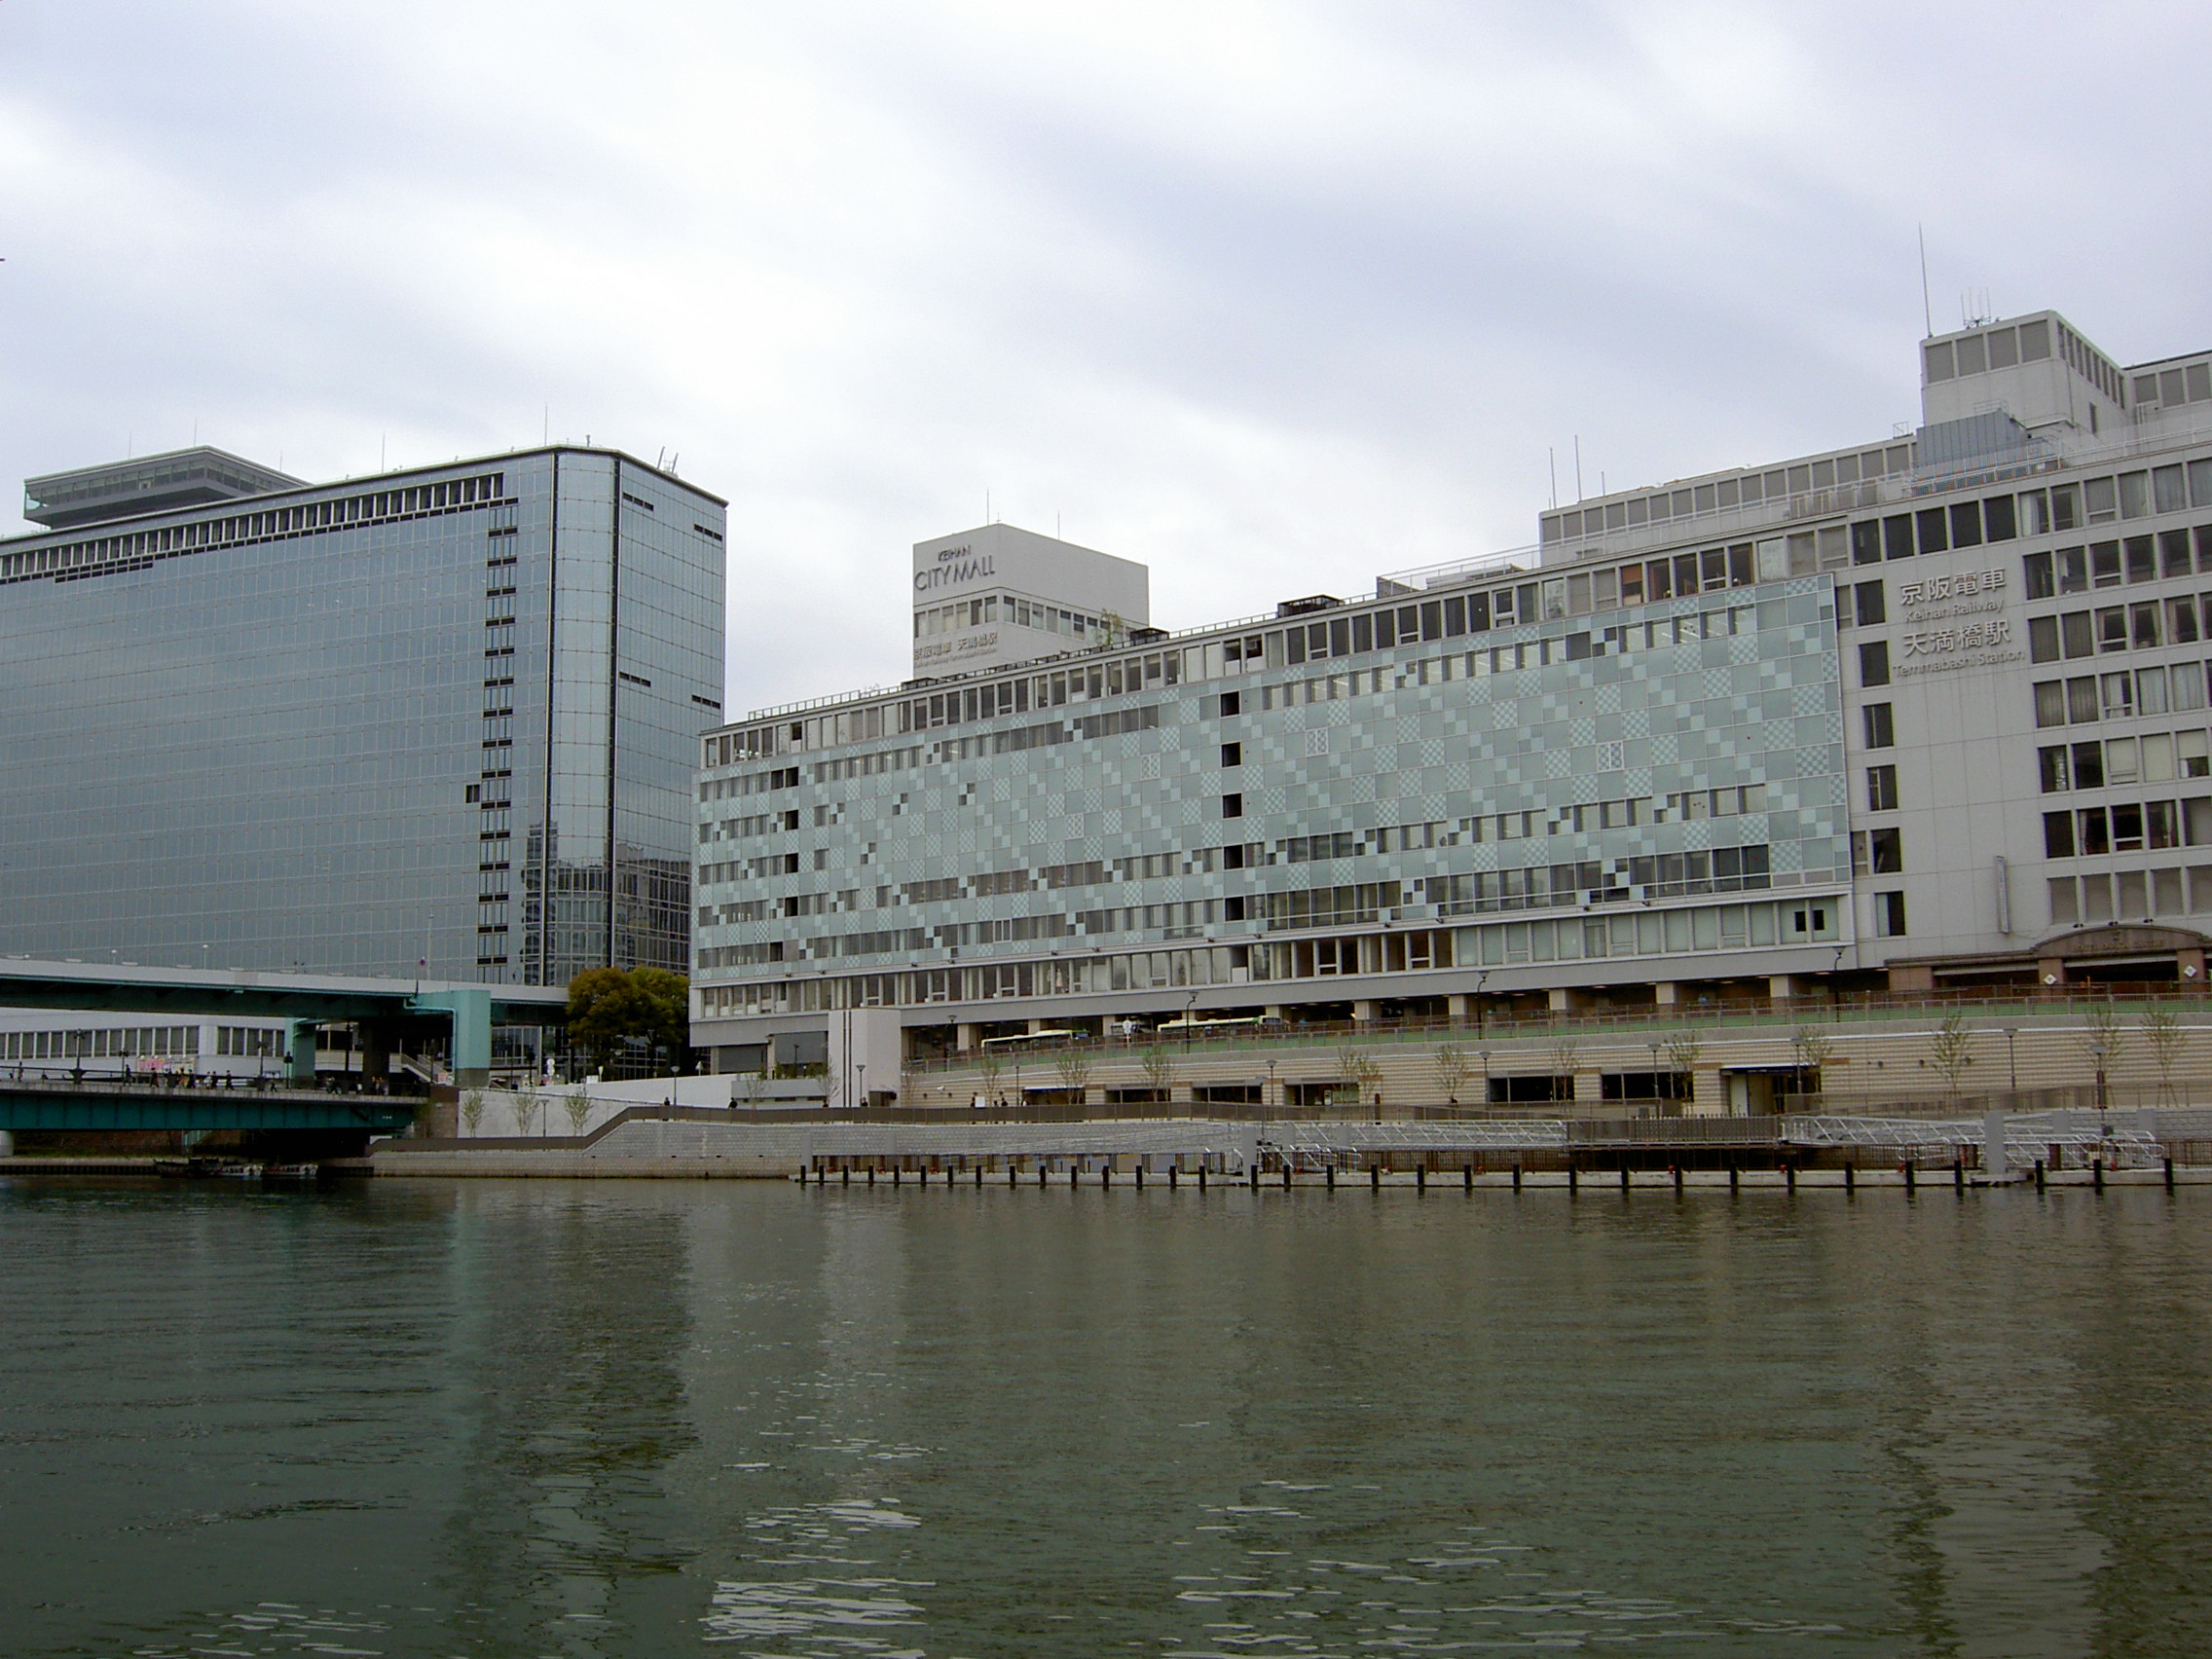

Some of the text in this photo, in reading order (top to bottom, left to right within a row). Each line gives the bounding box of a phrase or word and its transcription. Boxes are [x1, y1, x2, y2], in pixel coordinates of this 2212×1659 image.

[938, 544, 971, 562] KEIHAN
[914, 555, 996, 591] CITY MALL
[1899, 567, 2007, 606] 京阪電車
[1905, 599, 2005, 623] Keihan Railway
[1902, 619, 2010, 658] 天満橋駅
[1978, 649, 2026, 667] Station
